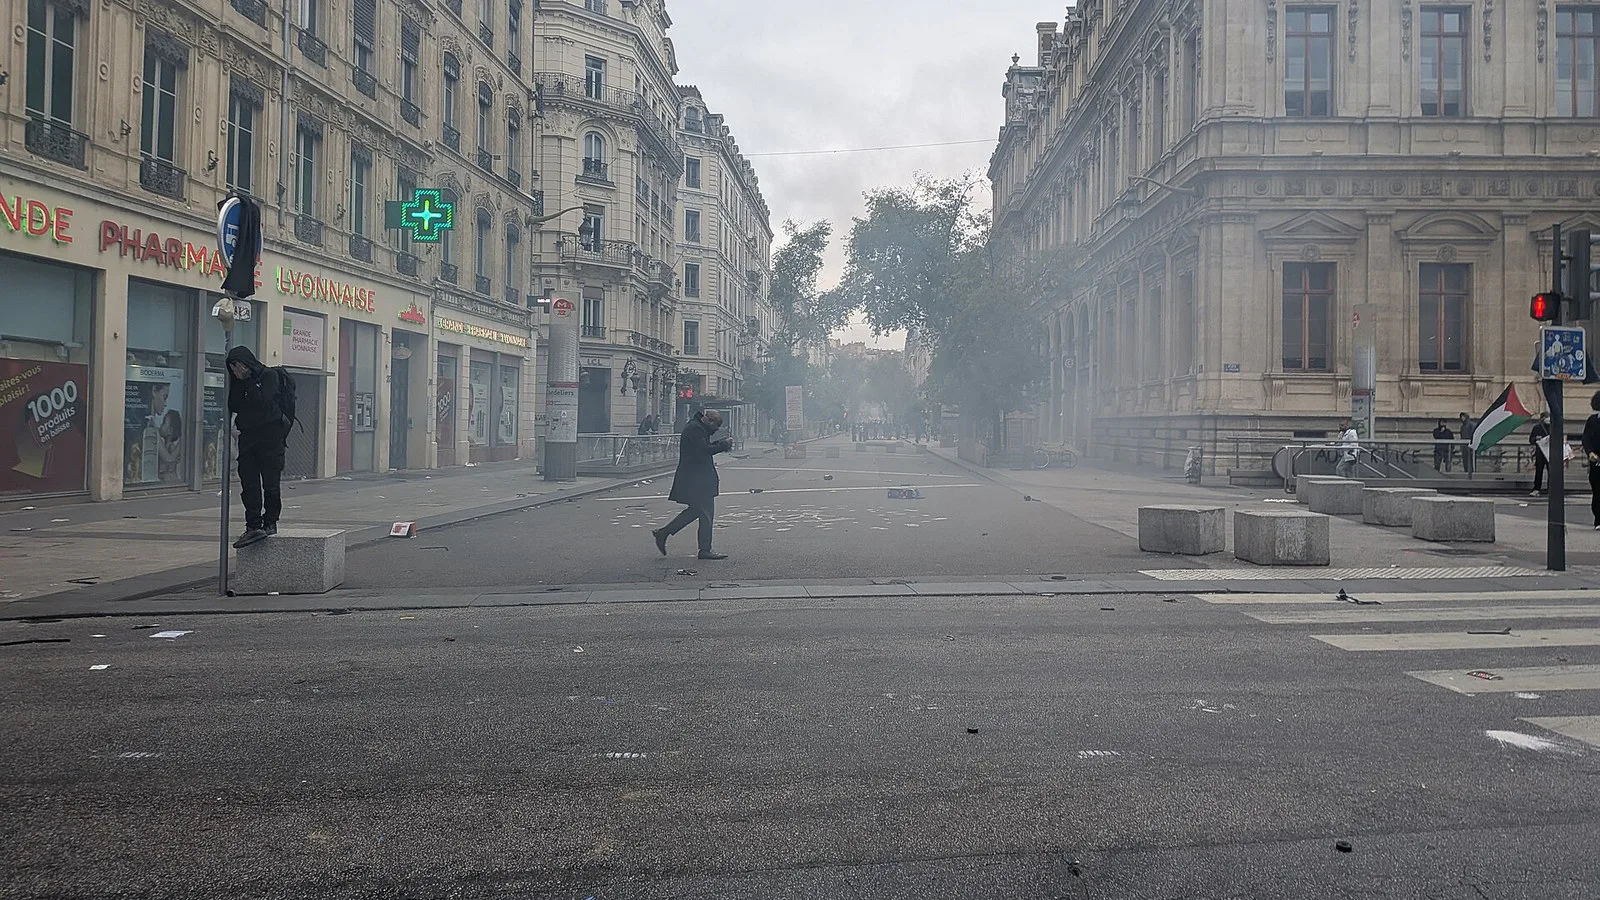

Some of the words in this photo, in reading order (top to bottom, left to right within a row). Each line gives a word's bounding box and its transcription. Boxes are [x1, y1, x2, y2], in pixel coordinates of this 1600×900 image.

[277, 264, 376, 314] LYONNAISE
[27, 380, 78, 423] 1000
[37, 406, 76, 436] produits
[40, 433, 51, 443] en
[50, 421, 71, 438] baisse
